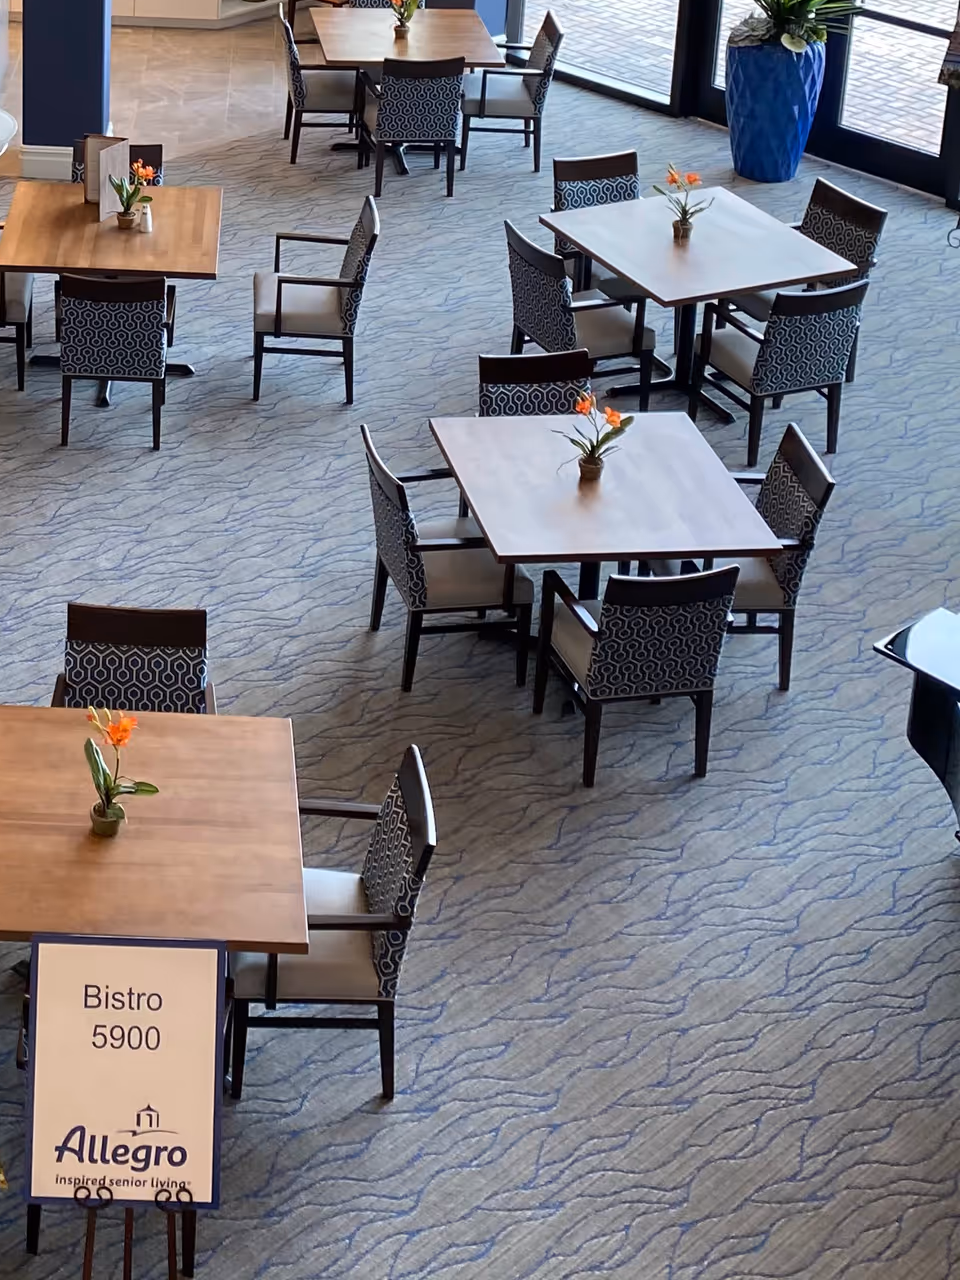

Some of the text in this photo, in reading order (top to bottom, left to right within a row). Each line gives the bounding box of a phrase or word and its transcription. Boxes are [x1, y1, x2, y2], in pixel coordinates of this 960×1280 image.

[83, 983, 163, 1012] Bistro
[91, 1024, 161, 1051] 5900
[54, 1125, 187, 1172] Allegro
[55, 1174, 106, 1187] inspired
[109, 1177, 148, 1187] senior
